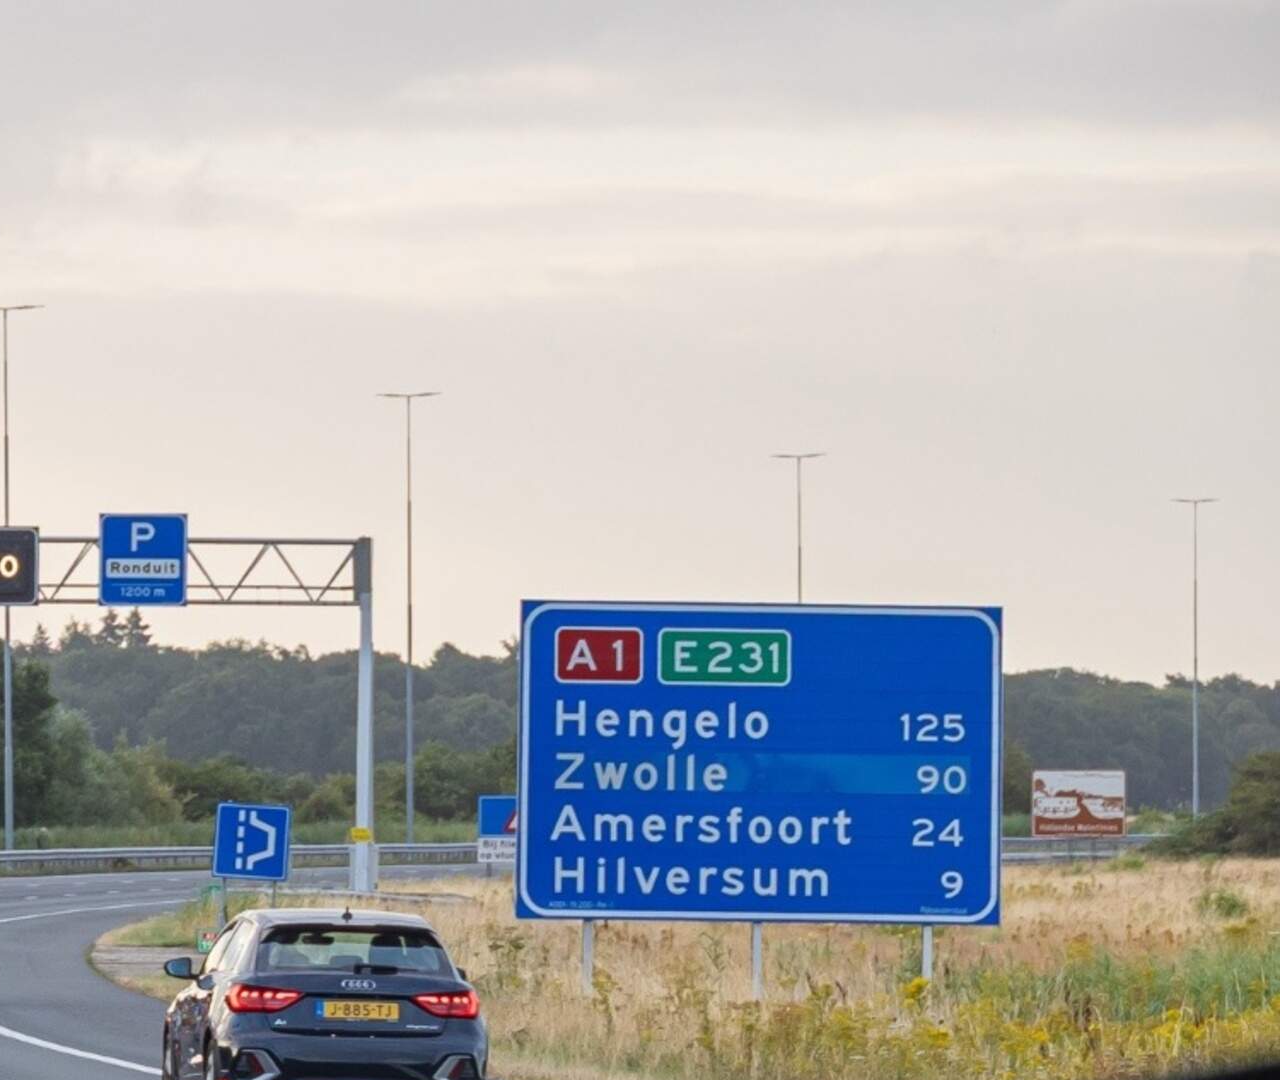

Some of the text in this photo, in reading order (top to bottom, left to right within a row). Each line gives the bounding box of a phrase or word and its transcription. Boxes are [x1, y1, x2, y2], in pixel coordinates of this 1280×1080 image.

[130, 522, 156, 552] P
[110, 561, 176, 574] Ronduit
[121, 586, 166, 597] 1200 m
[566, 639, 625, 672] A1
[673, 640, 781, 674] E231
[554, 699, 966, 750] Hengelo 125
[553, 752, 967, 794] Zwolle 90
[550, 804, 964, 848] Amersfoort 24
[553, 856, 964, 899] Hilversum 9
[329, 1001, 394, 1017] J-885-TJ
